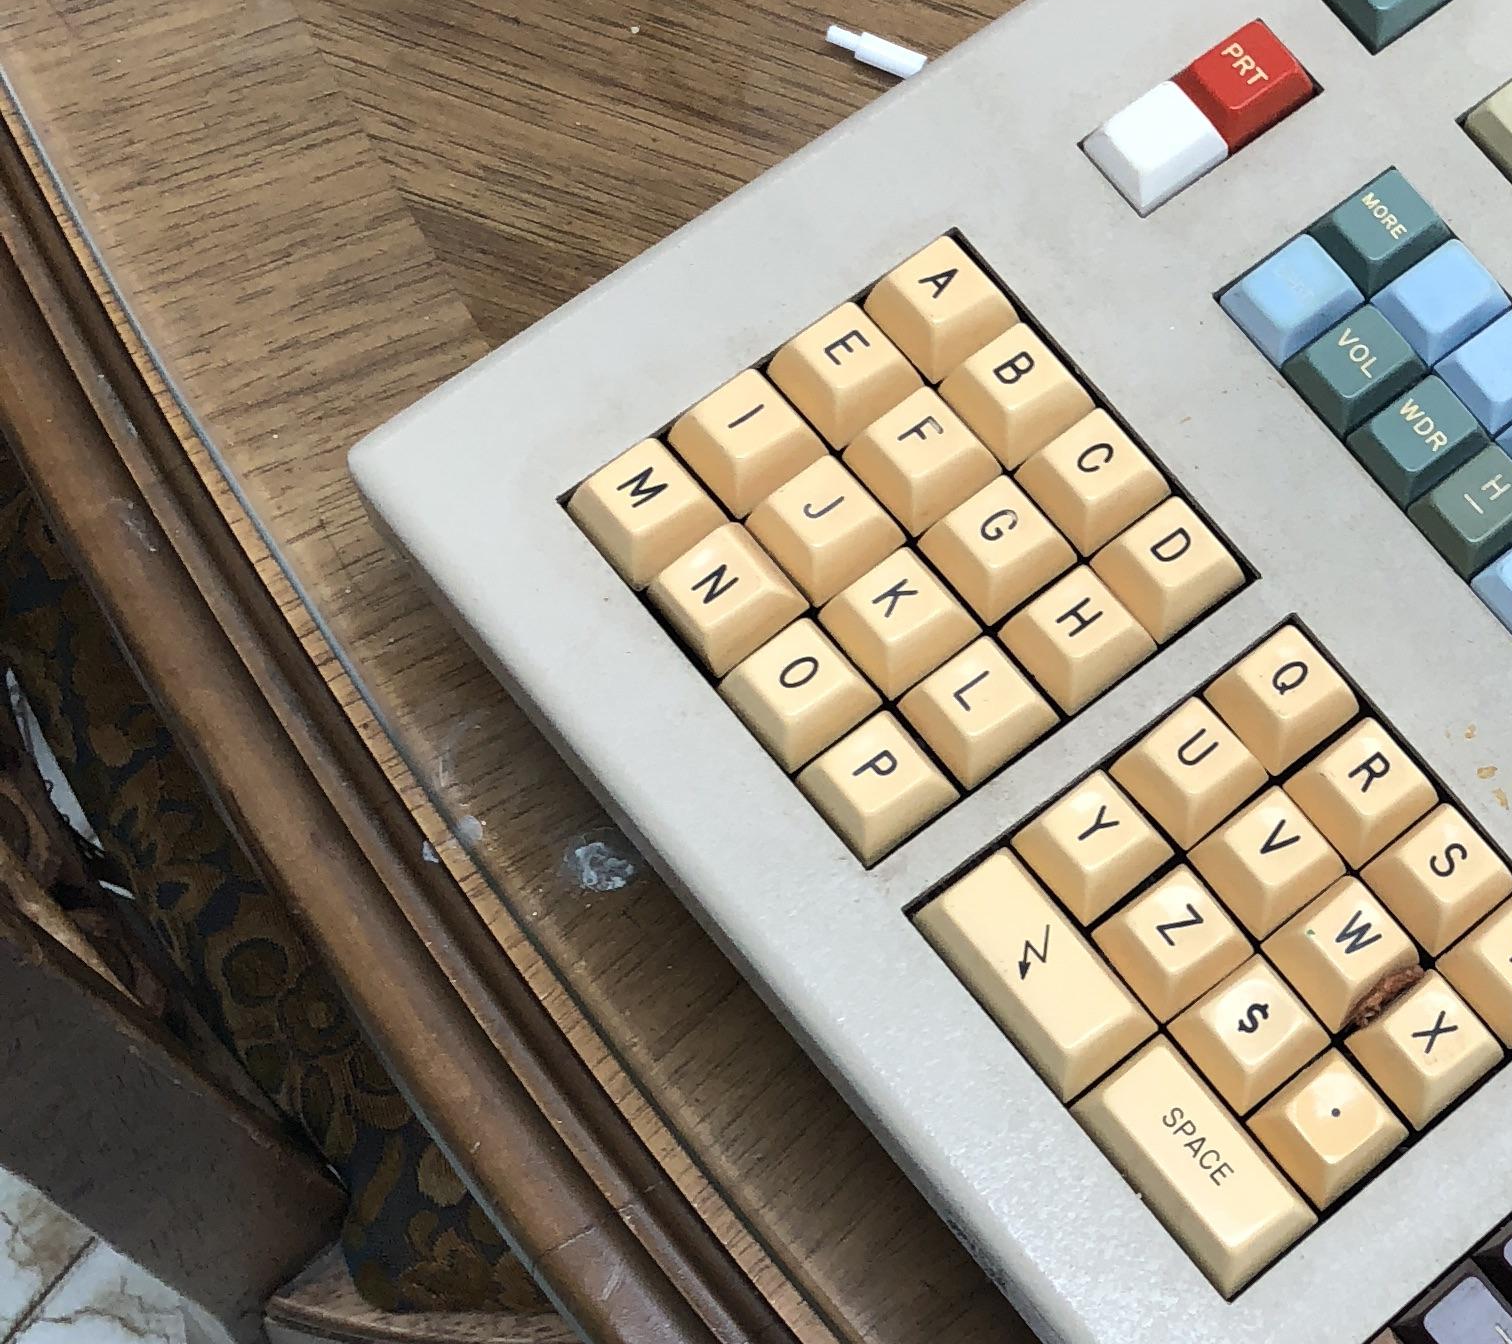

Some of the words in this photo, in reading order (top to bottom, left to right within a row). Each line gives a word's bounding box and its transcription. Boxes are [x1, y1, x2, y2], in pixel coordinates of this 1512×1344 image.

[1221, 43, 1269, 86] PRT
[1361, 191, 1408, 240] MORE
[917, 267, 959, 299] A
[823, 329, 872, 366] E
[1336, 327, 1374, 380] VOL
[992, 351, 1036, 385] B
[727, 403, 765, 429] I
[897, 415, 944, 442] F
[1399, 398, 1449, 452] WDR
[1076, 442, 1115, 474] C
[616, 466, 668, 509] M
[802, 495, 845, 520] J
[979, 508, 1019, 542] G
[1149, 526, 1192, 563] D
[691, 563, 740, 604] N
[872, 578, 919, 618] K
[1054, 596, 1104, 638] H
[778, 656, 819, 689] O
[952, 670, 990, 712] L
[1271, 660, 1308, 695] Q
[852, 749, 898, 777] P
[1177, 727, 1219, 767] U
[1347, 751, 1390, 793] R
[1077, 804, 1121, 842] Y
[1259, 818, 1301, 855] V
[1429, 842, 1468, 878] S
[1156, 902, 1204, 946] Z
[1333, 909, 1383, 955] W
[1237, 1002, 1270, 1034] $
[1411, 1010, 1459, 1054] X
[1161, 1107, 1235, 1187] SPACE
